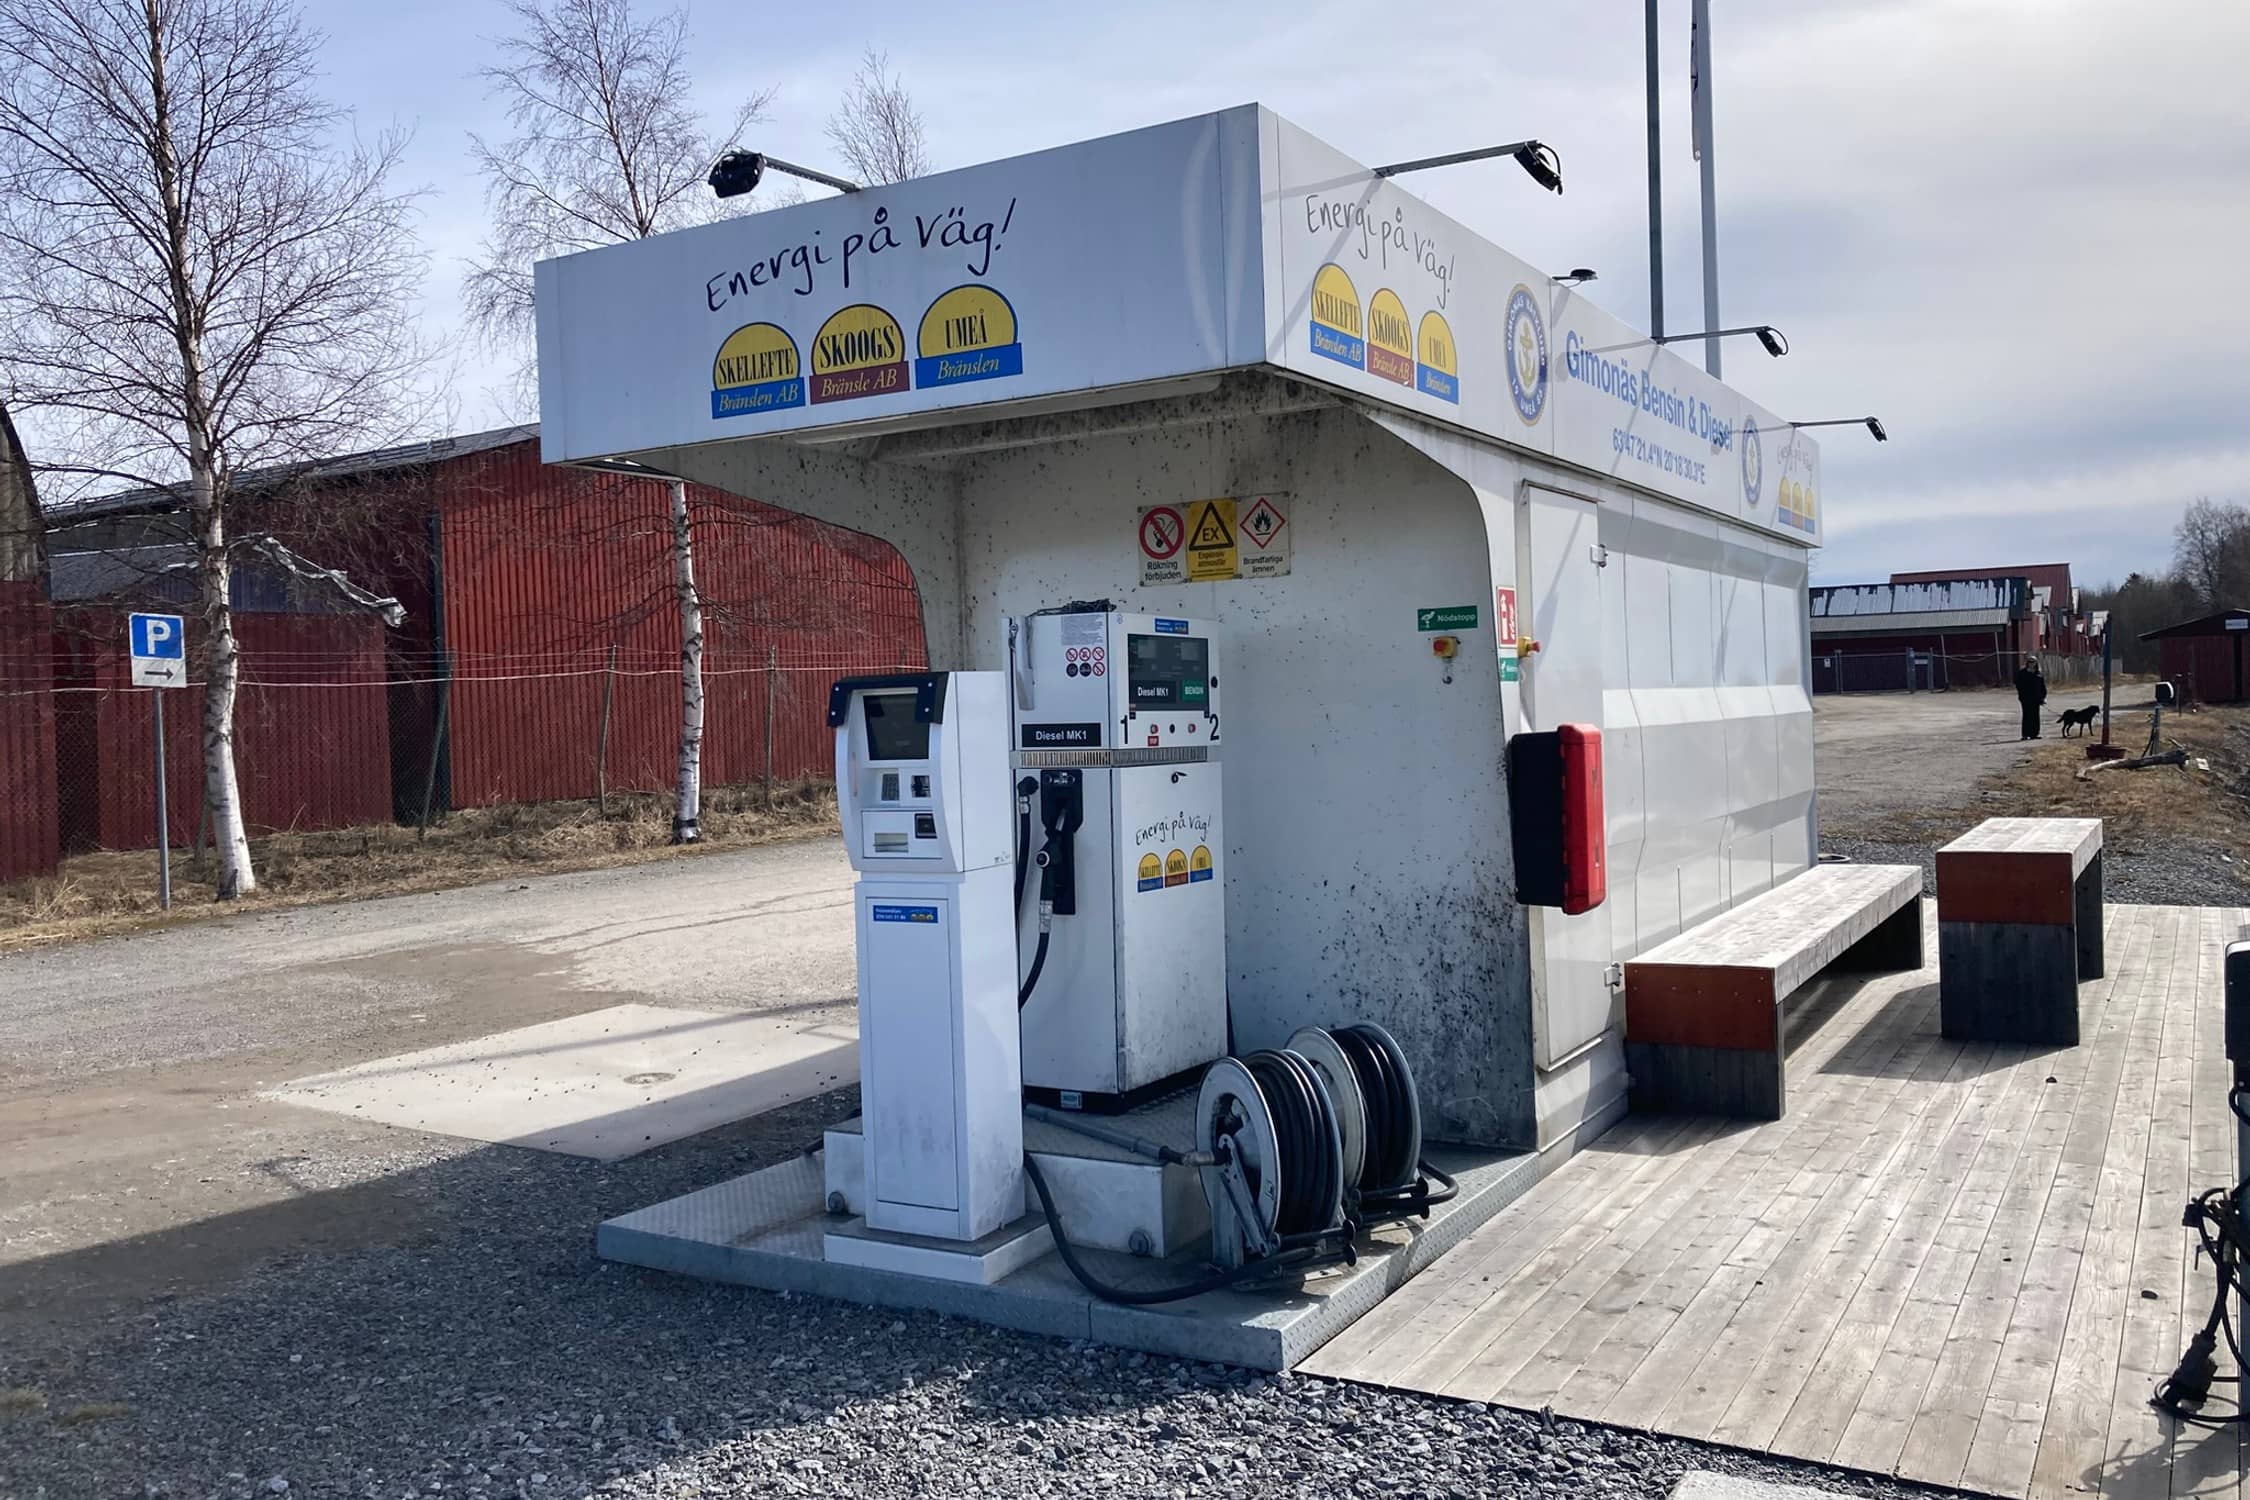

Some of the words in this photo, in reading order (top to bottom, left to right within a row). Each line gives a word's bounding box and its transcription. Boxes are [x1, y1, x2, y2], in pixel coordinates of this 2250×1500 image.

[1306, 194, 1376, 260] Energi
[1382, 206, 1409, 270] på
[706, 231, 832, 312] Energi
[843, 207, 901, 288] på
[1315, 291, 1359, 334] SKELLEFTE
[945, 308, 988, 349] UMEÅ
[1372, 309, 1409, 353] SKOOGS
[819, 325, 896, 369] SKOOGS
[1351, 343, 1362, 362] AB
[719, 347, 793, 385] SKELLEFTE
[937, 357, 999, 380] Bränslen
[1398, 361, 1410, 379] AB
[719, 388, 773, 412] Bränslen
[777, 383, 799, 403] AB
[821, 374, 869, 397] Bränsle
[871, 369, 897, 390] AB
[1566, 330, 1638, 406] Gimonäs
[1641, 369, 1685, 429] Bensin
[1689, 396, 1697, 435] &
[1700, 401, 1733, 452] Diesel
[1202, 527, 1220, 542] EX
[1147, 561, 1177, 570] Rökning
[1437, 614, 1476, 623] Nödstopp
[146, 619, 171, 655] P
[1138, 686, 1156, 697] Diesel
[1156, 687, 1168, 697] MK1
[1036, 730, 1064, 741] Diesel
[1067, 730, 1087, 740] MK1
[1120, 714, 1128, 745] 1
[1209, 713, 1220, 741] 2
[1136, 816, 1169, 846] Energi
[1172, 811, 1186, 840] på
